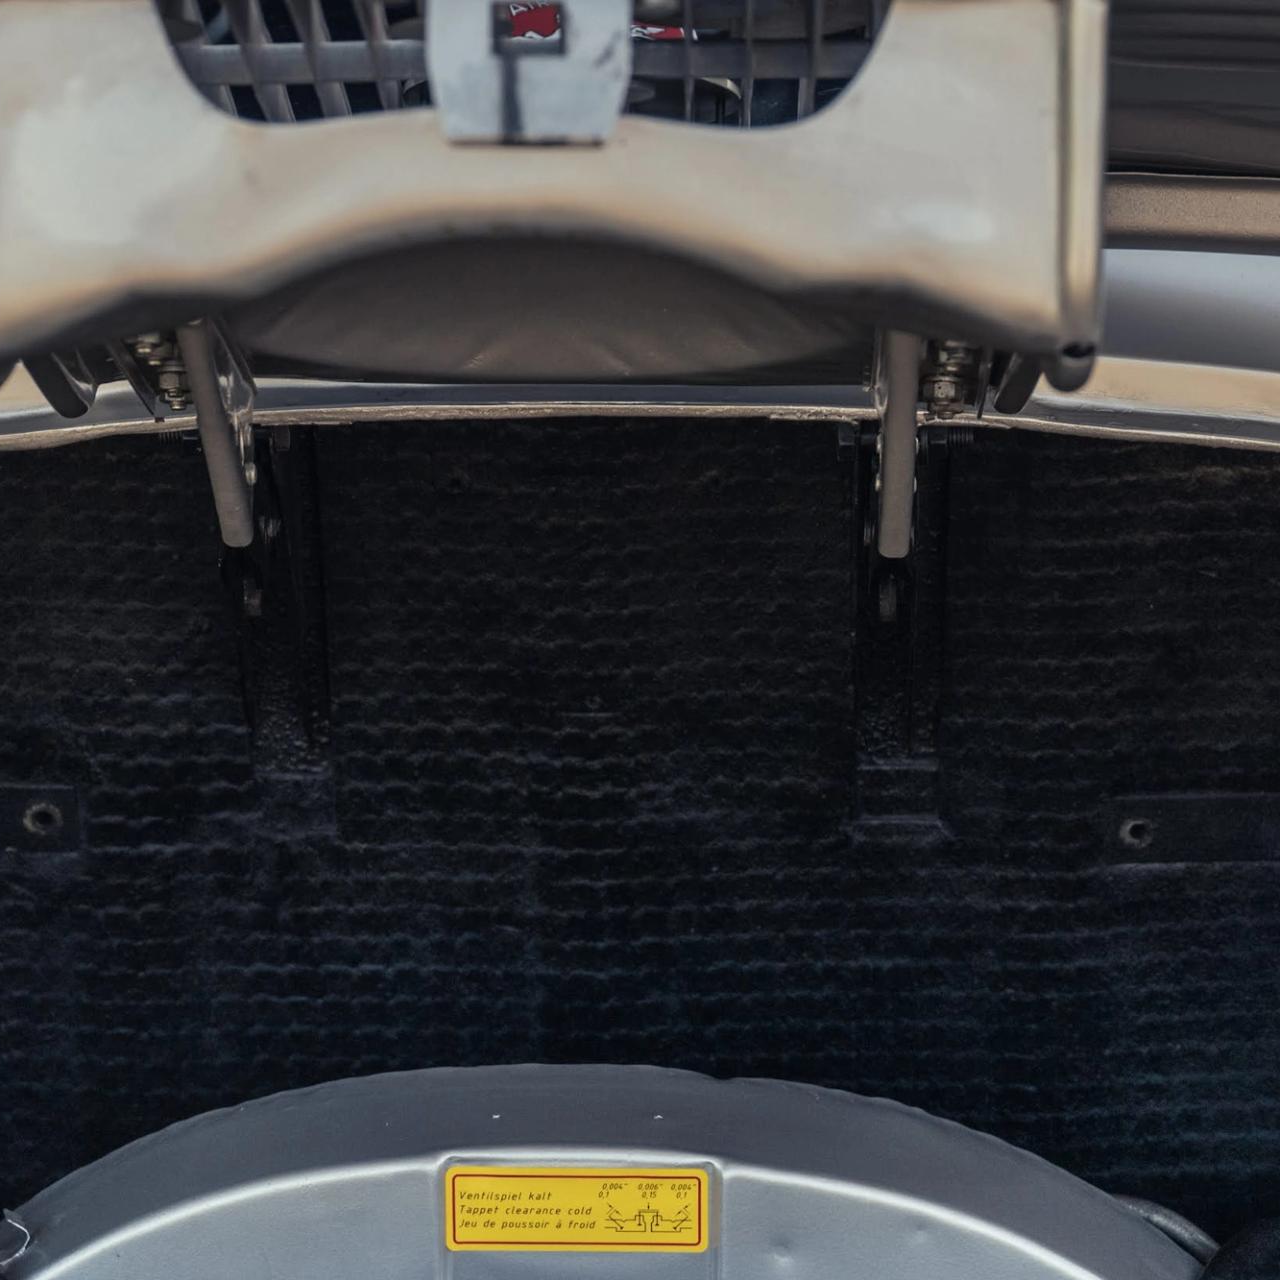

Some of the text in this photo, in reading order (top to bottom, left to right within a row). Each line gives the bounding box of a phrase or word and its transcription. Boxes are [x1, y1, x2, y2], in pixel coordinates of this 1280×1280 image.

[459, 1191, 553, 1202] Ventilspiel kalt
[459, 1205, 593, 1216] Tappet clearance cold
[459, 1219, 478, 1229] Jeu
[483, 1219, 496, 1229] de
[501, 1220, 550, 1230] poussoir
[568, 1220, 597, 1230] froid
